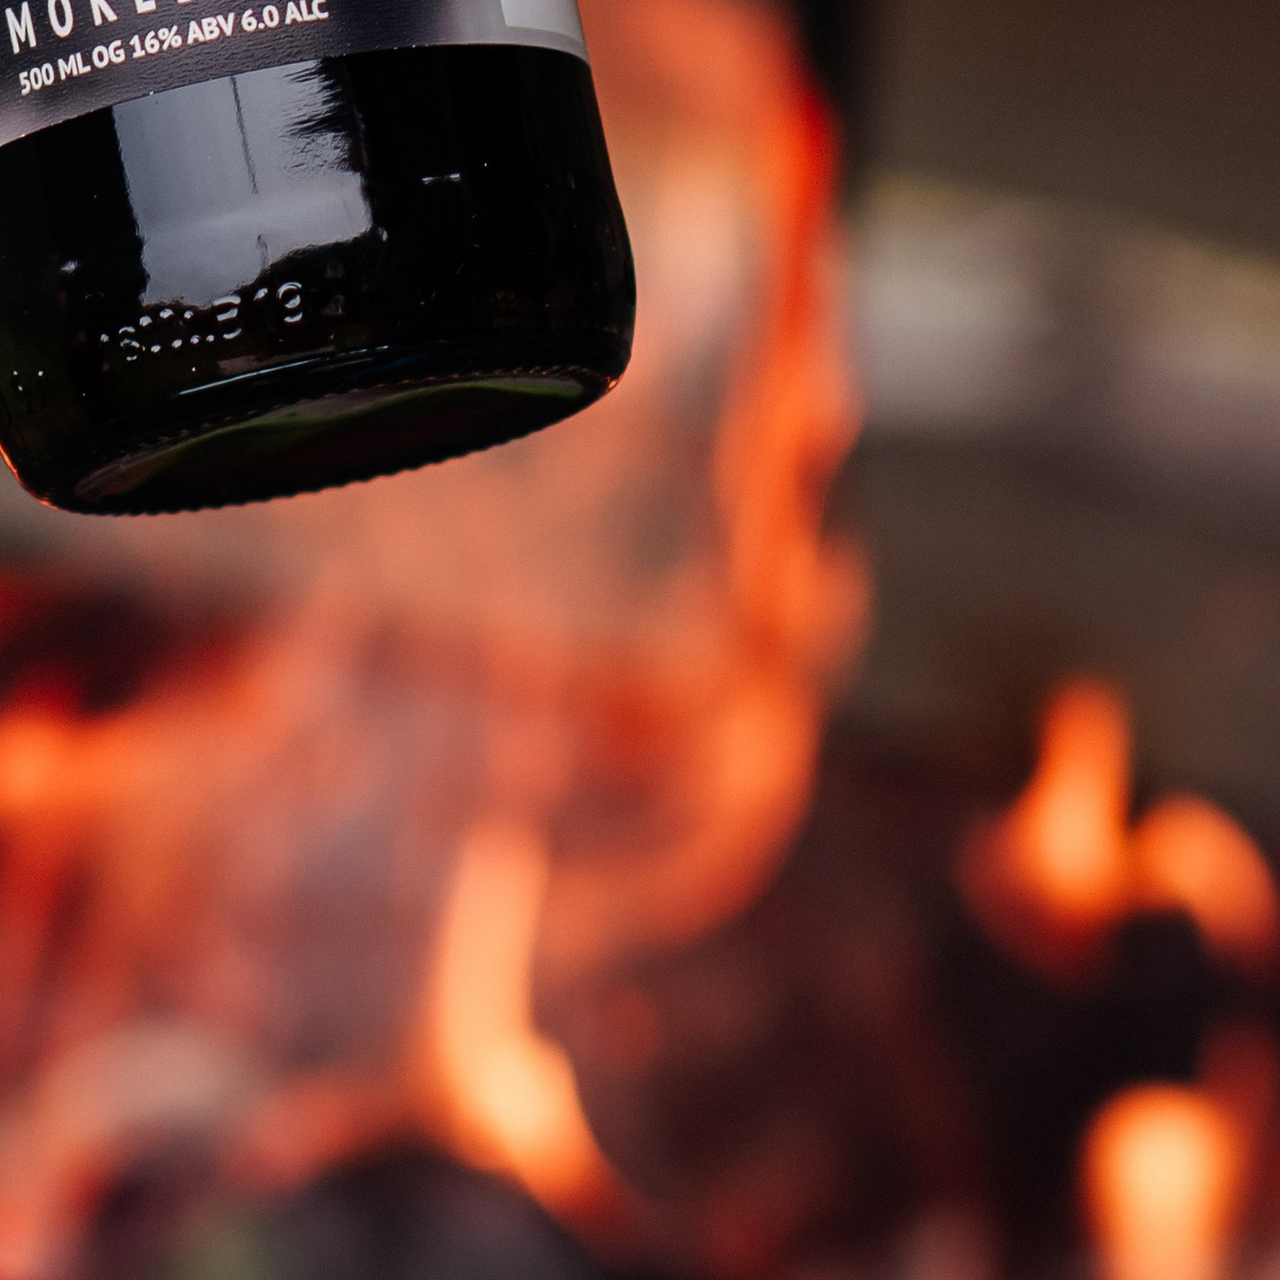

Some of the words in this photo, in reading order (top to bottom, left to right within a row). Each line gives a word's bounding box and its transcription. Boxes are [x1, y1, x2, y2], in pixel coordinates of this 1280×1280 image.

[19, 62, 54, 95] 500
[58, 50, 90, 83] ML
[92, 39, 125, 67] OG
[129, 25, 182, 58] 16%
[186, 13, 235, 45] ABV
[241, 4, 280, 32] 6.0
